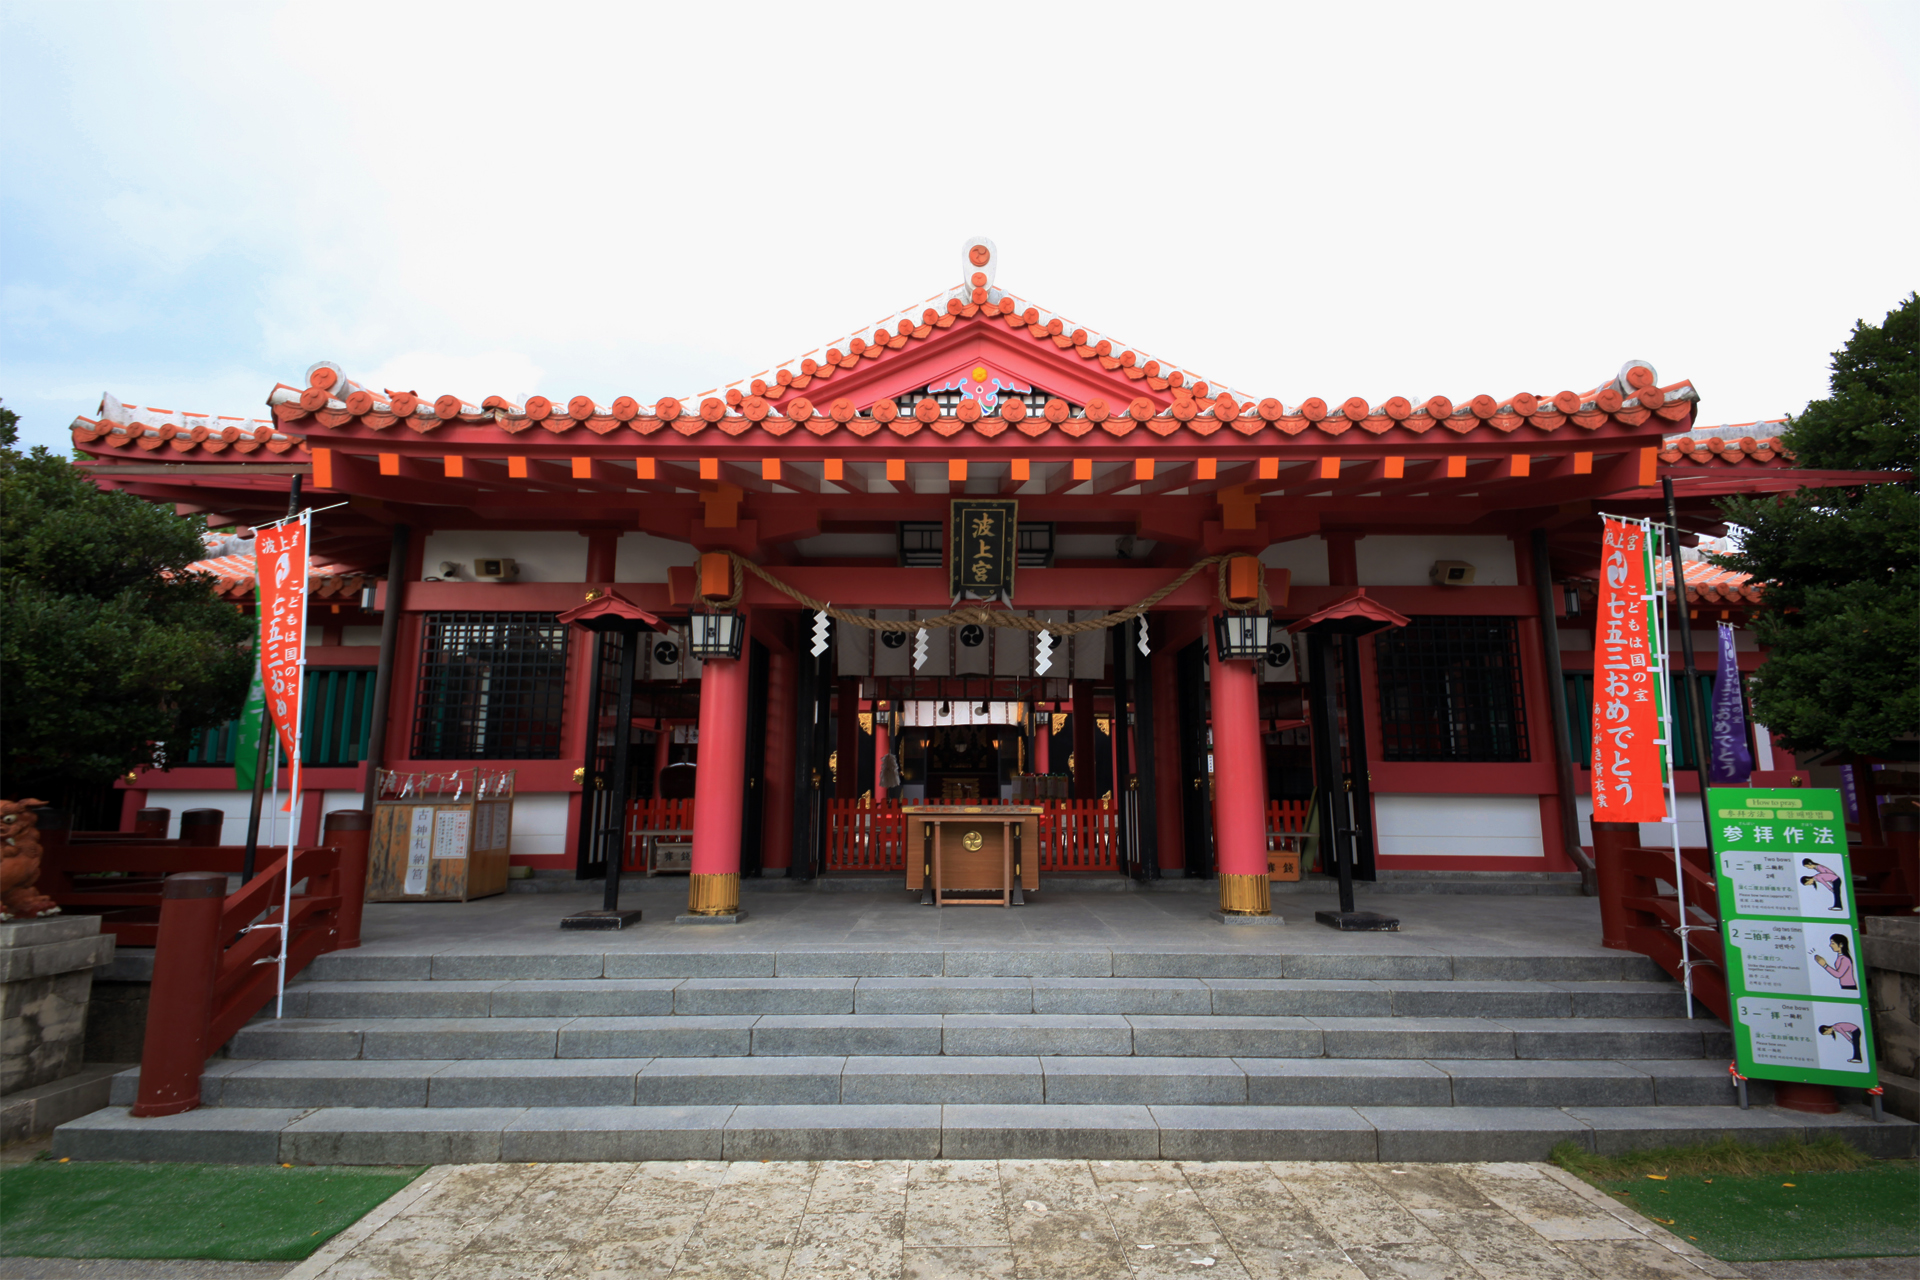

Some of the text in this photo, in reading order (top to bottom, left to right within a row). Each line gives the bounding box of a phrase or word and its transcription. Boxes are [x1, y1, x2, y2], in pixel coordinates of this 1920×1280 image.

[971, 512, 996, 582] 波上宮
[1627, 584, 1649, 702] こどもは国の宝
[1603, 592, 1635, 805] 七五三おめでとう
[1593, 702, 1608, 808] あらがき貸衣裳
[1780, 800, 1797, 808] pray.
[1723, 825, 1834, 845] 参拝作法
[1724, 860, 1729, 868] 1
[1732, 928, 1739, 938] 2
[1744, 933, 1771, 941] 二拍手
[1741, 1006, 1748, 1016] 3
